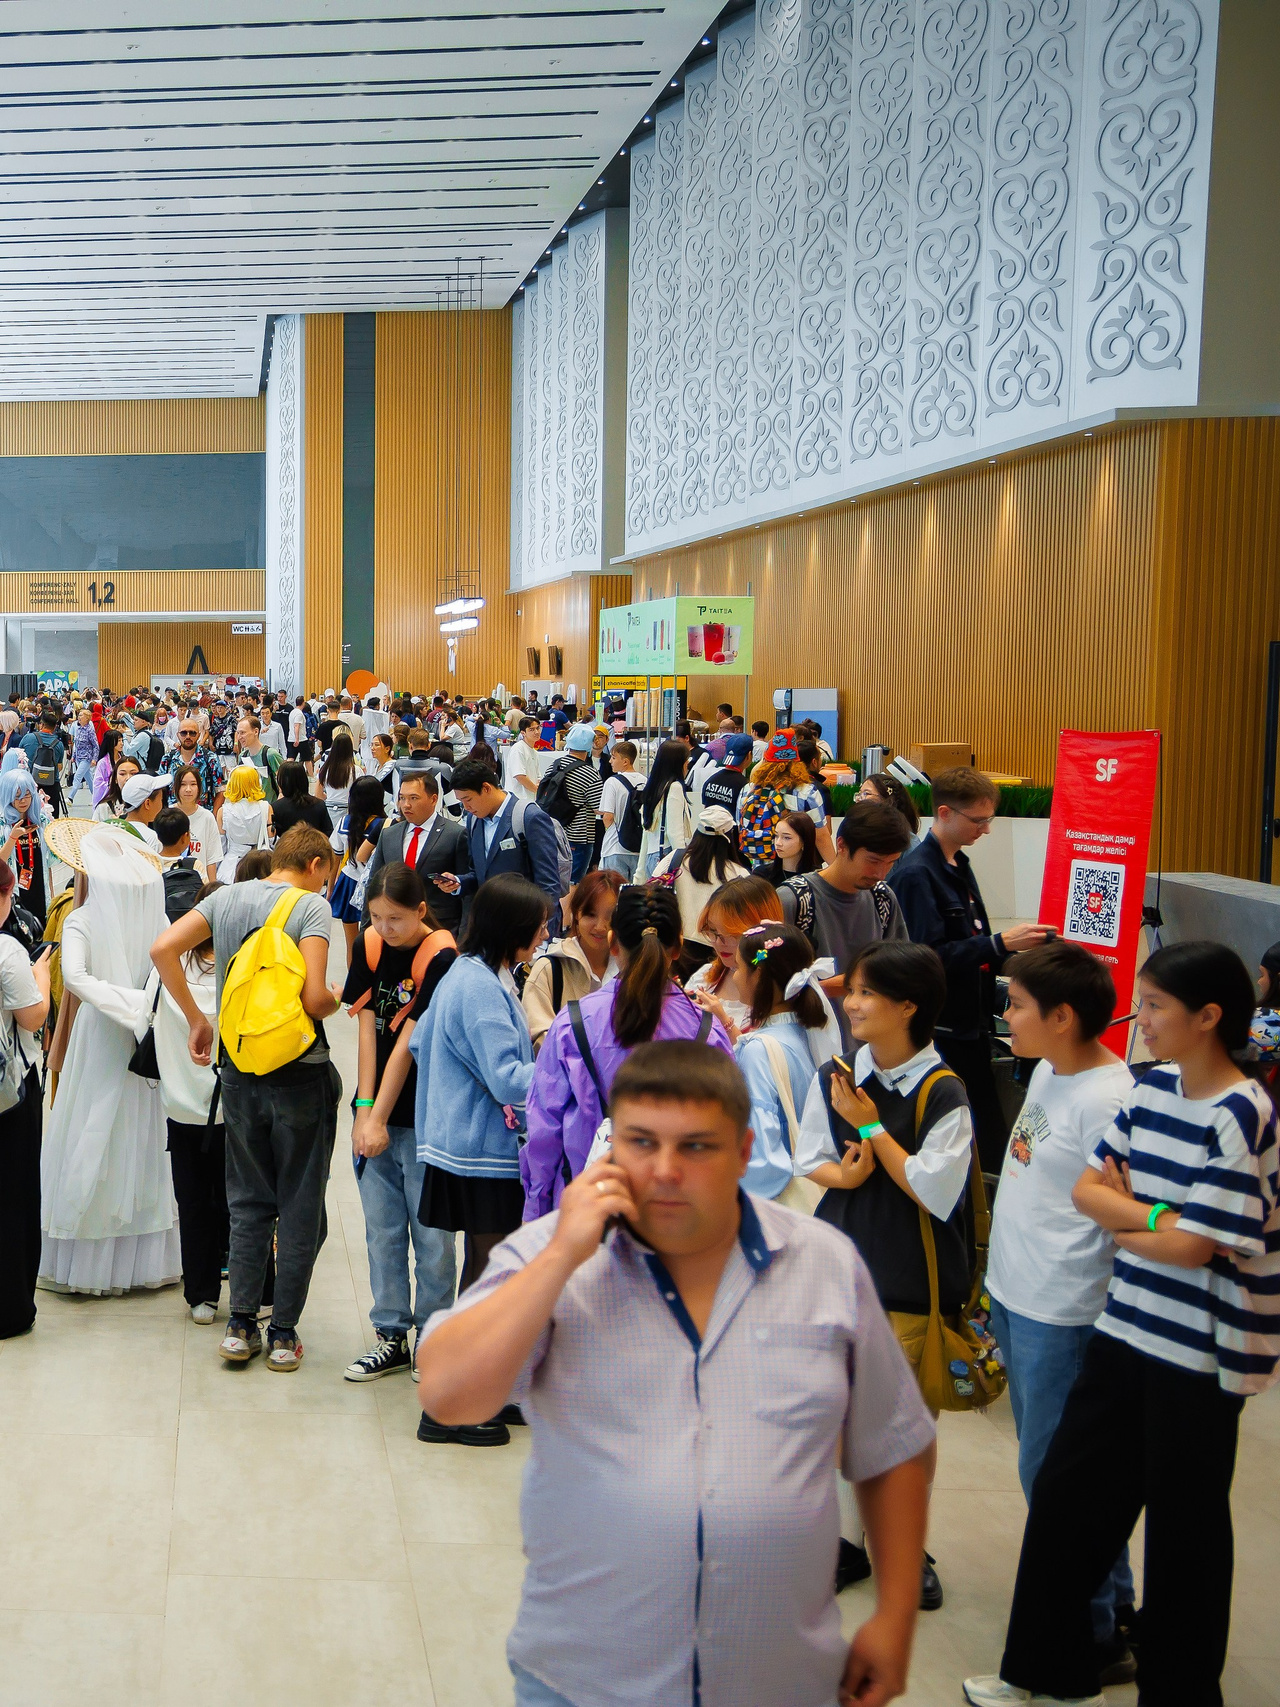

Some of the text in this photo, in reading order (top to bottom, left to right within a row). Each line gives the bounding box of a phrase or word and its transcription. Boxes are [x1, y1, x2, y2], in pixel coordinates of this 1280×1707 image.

[88, 581, 115, 608] 1,2
[1095, 758, 1118, 782] SF
[705, 782, 733, 798] ASTANA
[1089, 896, 1101, 909] SF
